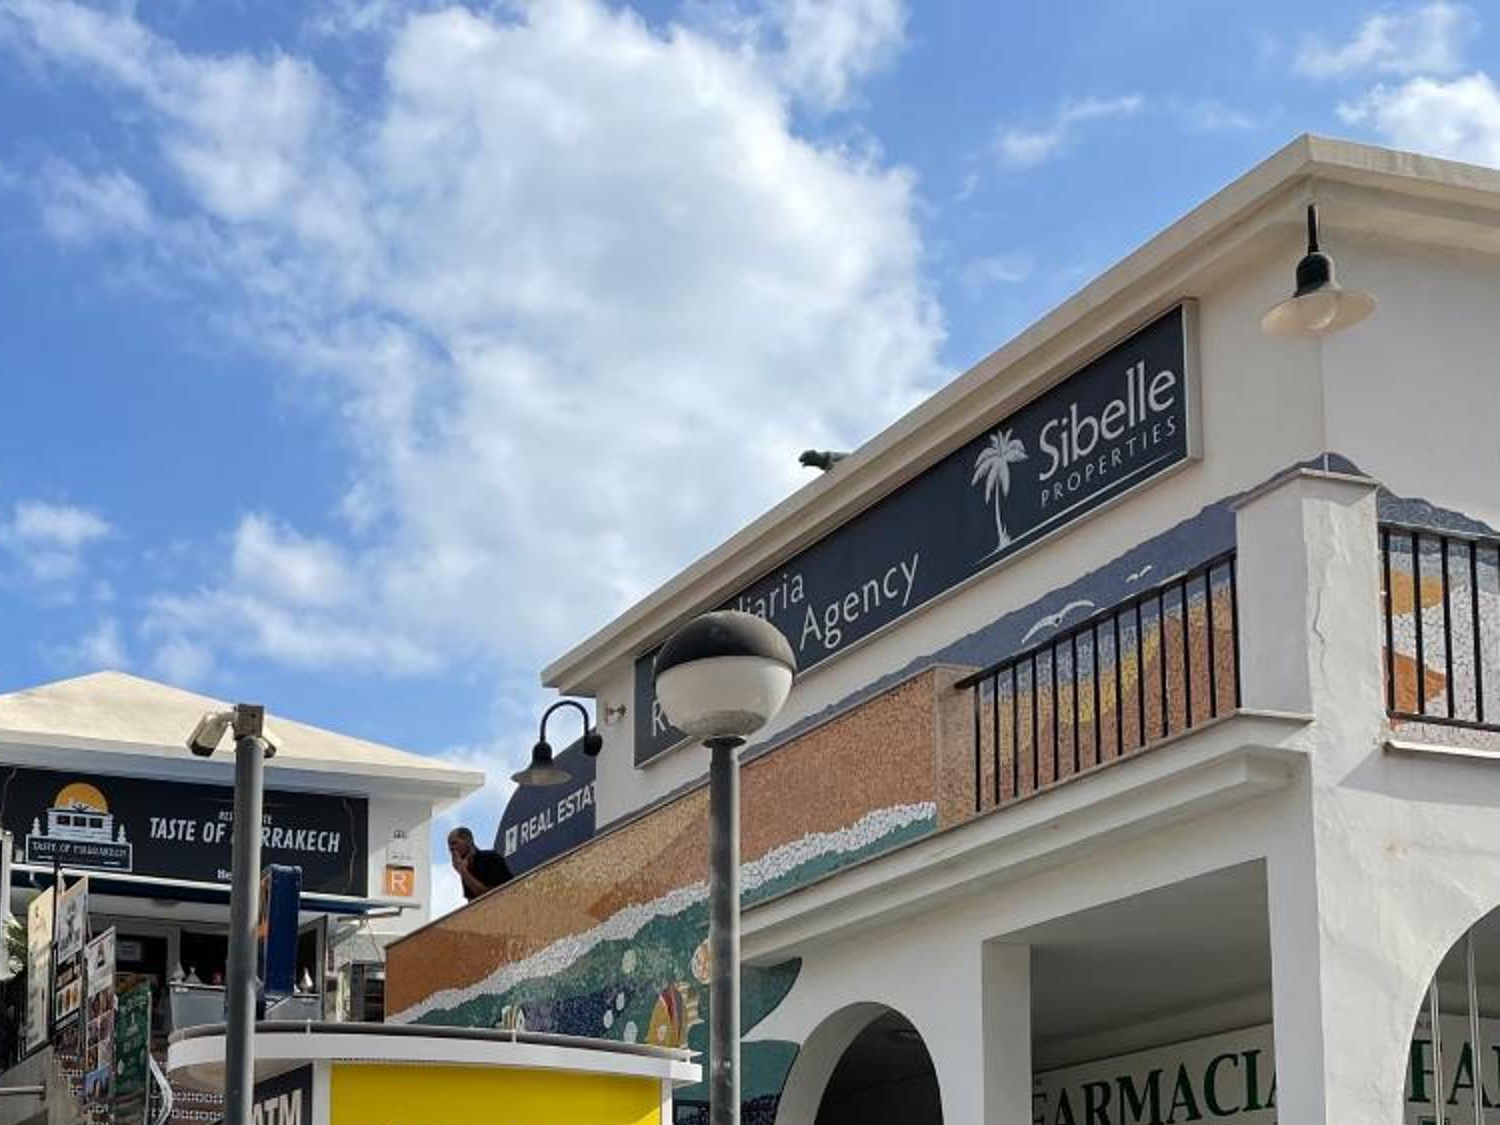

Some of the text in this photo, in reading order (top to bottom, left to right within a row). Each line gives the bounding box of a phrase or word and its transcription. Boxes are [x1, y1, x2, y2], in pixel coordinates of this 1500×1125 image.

[1038, 360, 1177, 481] Sibelle
[1040, 415, 1178, 508] PROPERTIES
[799, 552, 919, 651] Agency
[149, 817, 197, 841] TASTE
[203, 822, 226, 843] OF
[231, 827, 341, 853] RRAKECH
[520, 807, 555, 845] REAL
